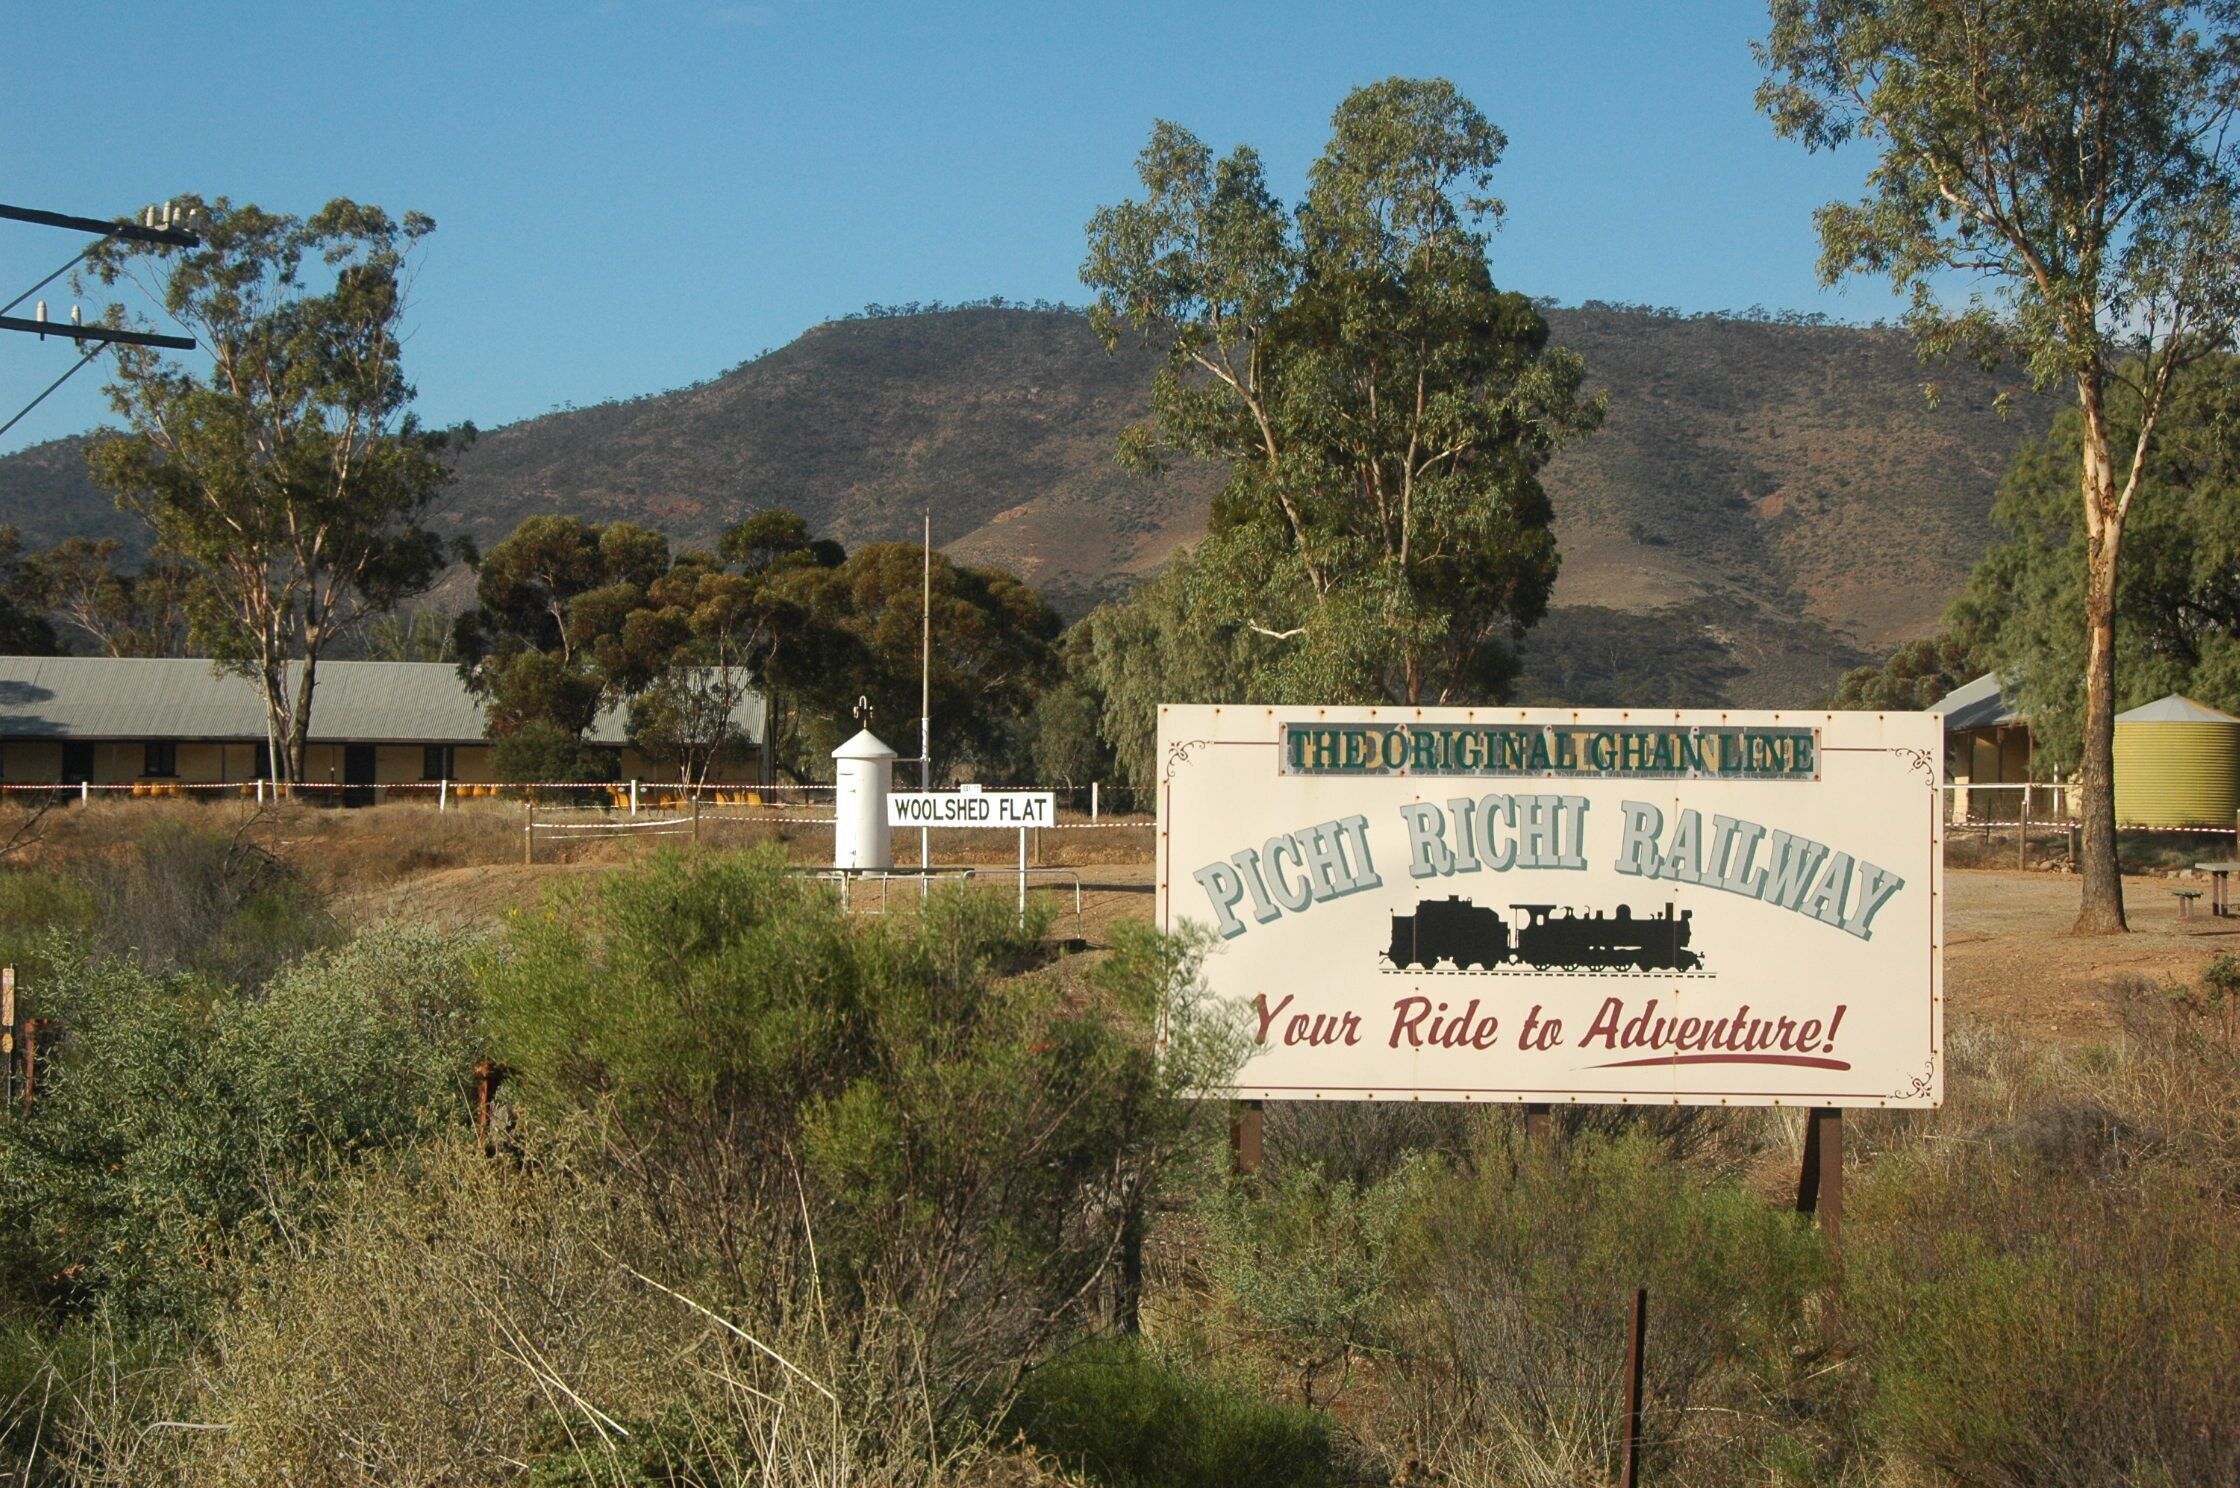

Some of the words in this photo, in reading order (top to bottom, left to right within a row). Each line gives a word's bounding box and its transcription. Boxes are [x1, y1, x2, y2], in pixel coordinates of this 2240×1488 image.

[1287, 730, 1367, 769] THE
[1381, 730, 1577, 771] ORIGINAL
[1591, 733, 1704, 772] GHAN
[1719, 734, 1813, 773] LINE
[895, 798, 989, 821] WOOLSHED
[1000, 798, 1047, 821] FLAT
[1192, 814, 1383, 939] PICHI
[1400, 794, 1590, 878] RICHI
[1614, 799, 1905, 942] RAILWAY
[1253, 993, 1362, 1047] Your
[1388, 996, 1499, 1050] Ride
[1518, 1004, 1564, 1051] to
[1578, 997, 1848, 1053] Adventure!
